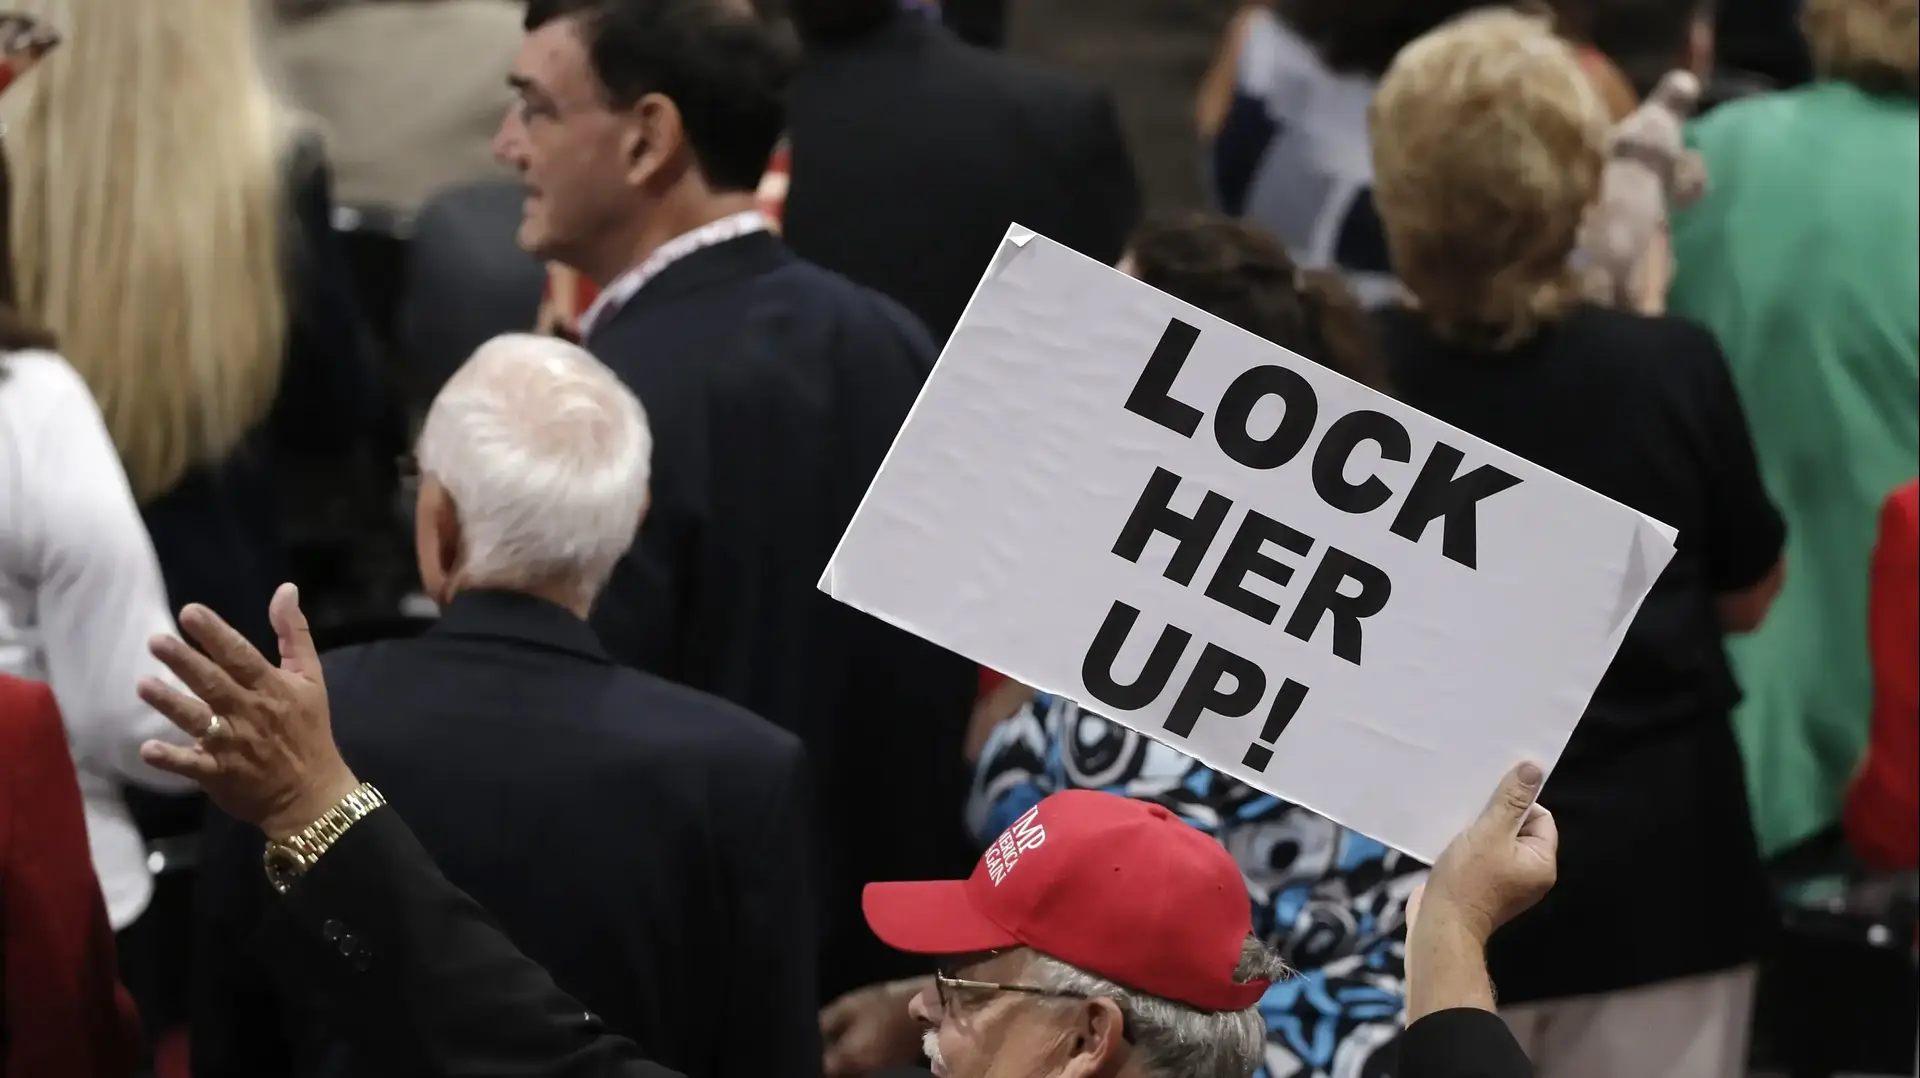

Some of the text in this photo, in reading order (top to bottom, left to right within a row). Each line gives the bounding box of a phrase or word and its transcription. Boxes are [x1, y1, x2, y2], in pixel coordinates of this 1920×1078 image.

[1123, 317, 1525, 571] LOCK
[1110, 465, 1392, 666] HER
[1081, 599, 1310, 774] UP!
[998, 827, 1019, 873] MERICA
